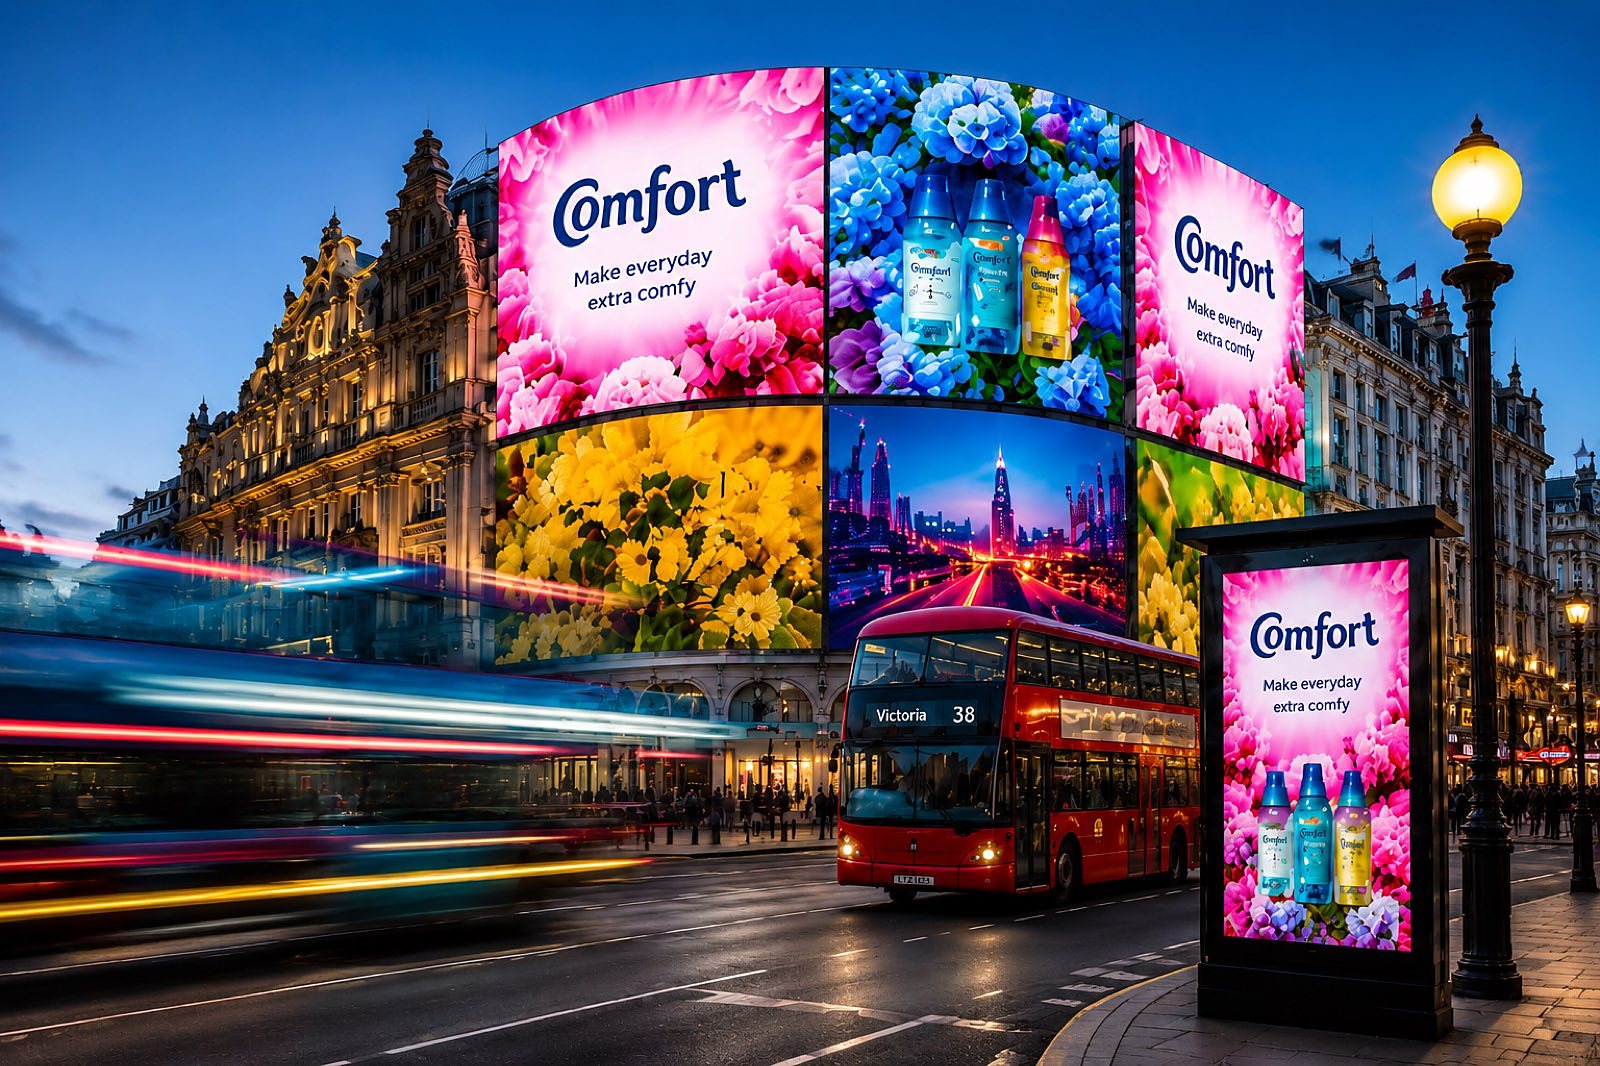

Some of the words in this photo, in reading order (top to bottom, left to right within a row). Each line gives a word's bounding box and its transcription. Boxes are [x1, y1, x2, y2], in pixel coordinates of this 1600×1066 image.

[553, 159, 747, 248] Comfort
[574, 265, 621, 288] Make
[626, 249, 713, 275] everyday
[1174, 214, 1276, 300] Comfort
[587, 291, 632, 311] extra
[637, 277, 697, 302] comfy
[1187, 296, 1216, 321] Make
[1217, 312, 1263, 342] everyday
[1196, 328, 1223, 349] extra
[1224, 339, 1255, 362] comfy
[1250, 611, 1380, 660] Comfort
[1263, 678, 1298, 692] Make
[1300, 675, 1363, 692] everyday
[876, 707, 927, 722] Victoria
[952, 706, 975, 724] 38
[1273, 700, 1305, 713] extra
[1308, 697, 1351, 714] comfy
